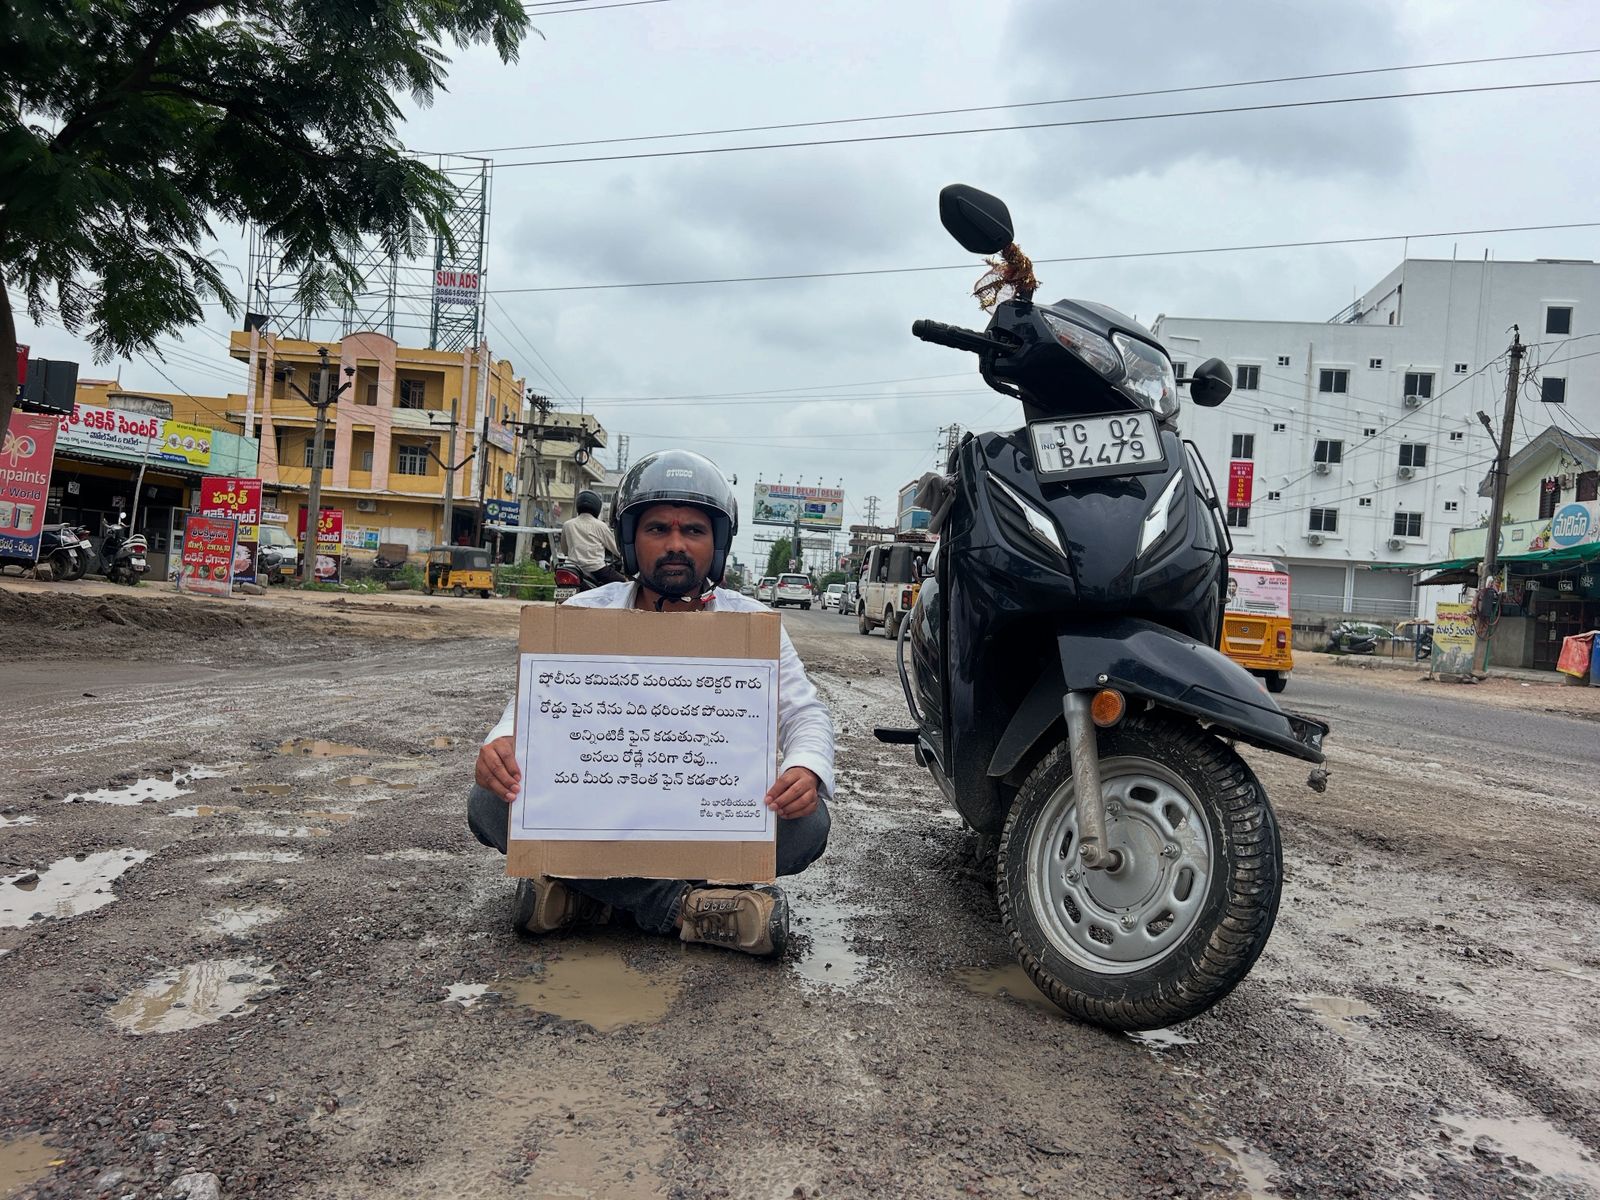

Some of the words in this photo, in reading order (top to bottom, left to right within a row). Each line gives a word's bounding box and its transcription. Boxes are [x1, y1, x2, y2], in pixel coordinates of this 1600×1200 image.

[437, 271, 456, 288] SUN
[459, 273, 478, 289] ADS
[83, 411, 115, 431] చికెన్
[119, 416, 158, 438] సెంటర్
[1054, 424, 1088, 446] TG
[1110, 417, 1143, 440] 02
[1060, 440, 1145, 468] B4479
[10, 487, 41, 500] World
[771, 486, 790, 494] DELHI
[797, 487, 816, 495] DELHI
[822, 489, 841, 498] DELHI
[539, 671, 581, 686] పోలీసు
[585, 673, 639, 686] కమిషనర్
[643, 675, 692, 687] మరియు
[696, 676, 732, 694] కలెక్టర్
[735, 678, 761, 689] గారు
[540, 701, 567, 719] రోడ్డు
[571, 703, 593, 717] పైన
[597, 703, 622, 715] నేను
[626, 703, 647, 715] ఏది
[651, 704, 700, 717] ధరించక
[702, 705, 759, 718] పోయినా...
[570, 727, 624, 744] అన్నింటికీ
[628, 729, 650, 747] ఫైన్
[654, 730, 728, 746] కడుతున్నాను.
[580, 750, 618, 762] అసలు
[623, 749, 643, 768] రోడ్లే
[648, 751, 679, 763] సరిగా
[682, 751, 717, 766] లేవు...
[554, 771, 579, 784] మరి
[583, 771, 613, 784] మీరు
[617, 773, 658, 784] నాకెంత
[662, 773, 683, 790] ఫైన్
[687, 773, 739, 786] కడతారు?
[701, 798, 710, 806] మీ
[712, 798, 756, 806] భారతీయుడు
[736, 810, 760, 818] కుమార్
